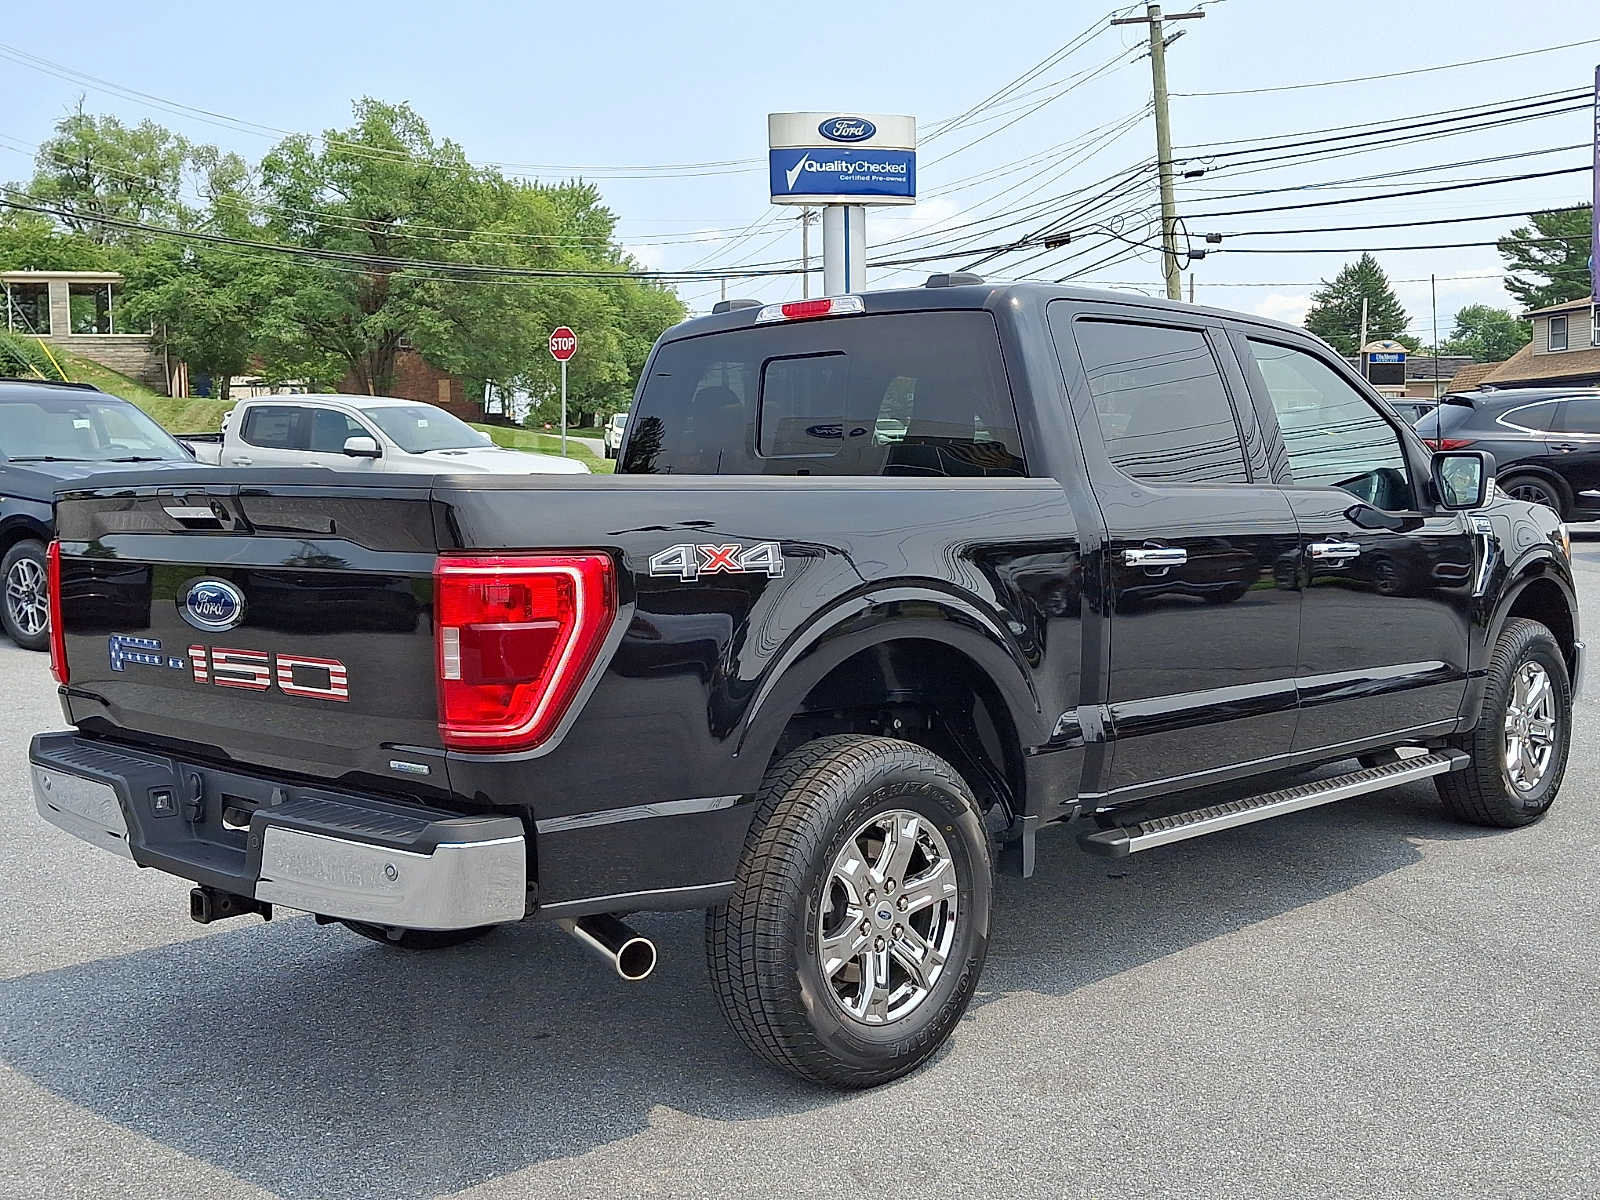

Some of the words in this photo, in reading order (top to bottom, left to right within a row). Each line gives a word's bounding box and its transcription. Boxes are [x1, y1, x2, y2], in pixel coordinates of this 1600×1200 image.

[832, 120, 865, 137] Ford
[804, 159, 907, 174] QualityChecked
[839, 174, 871, 182] Certified
[872, 175, 907, 183] Pre-owned
[551, 337, 575, 351] STOP
[194, 589, 226, 617] Ford
[108, 631, 351, 703] F-150
